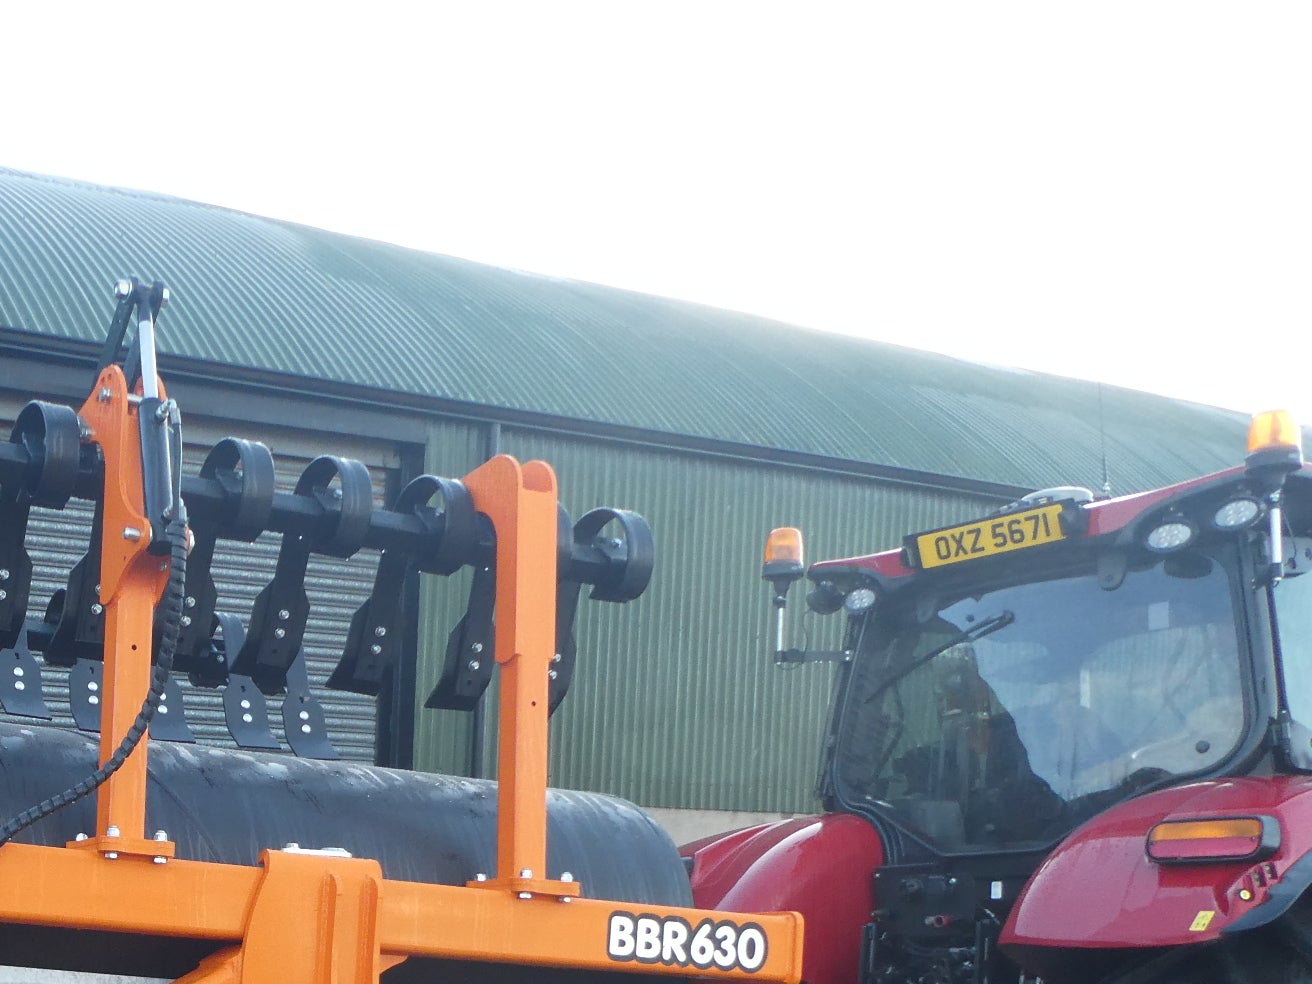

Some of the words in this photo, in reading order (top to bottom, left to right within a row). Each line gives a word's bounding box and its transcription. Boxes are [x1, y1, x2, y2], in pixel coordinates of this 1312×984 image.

[935, 527, 985, 560] OXZ
[991, 512, 1051, 548] 5671
[607, 913, 766, 970] BBR630
